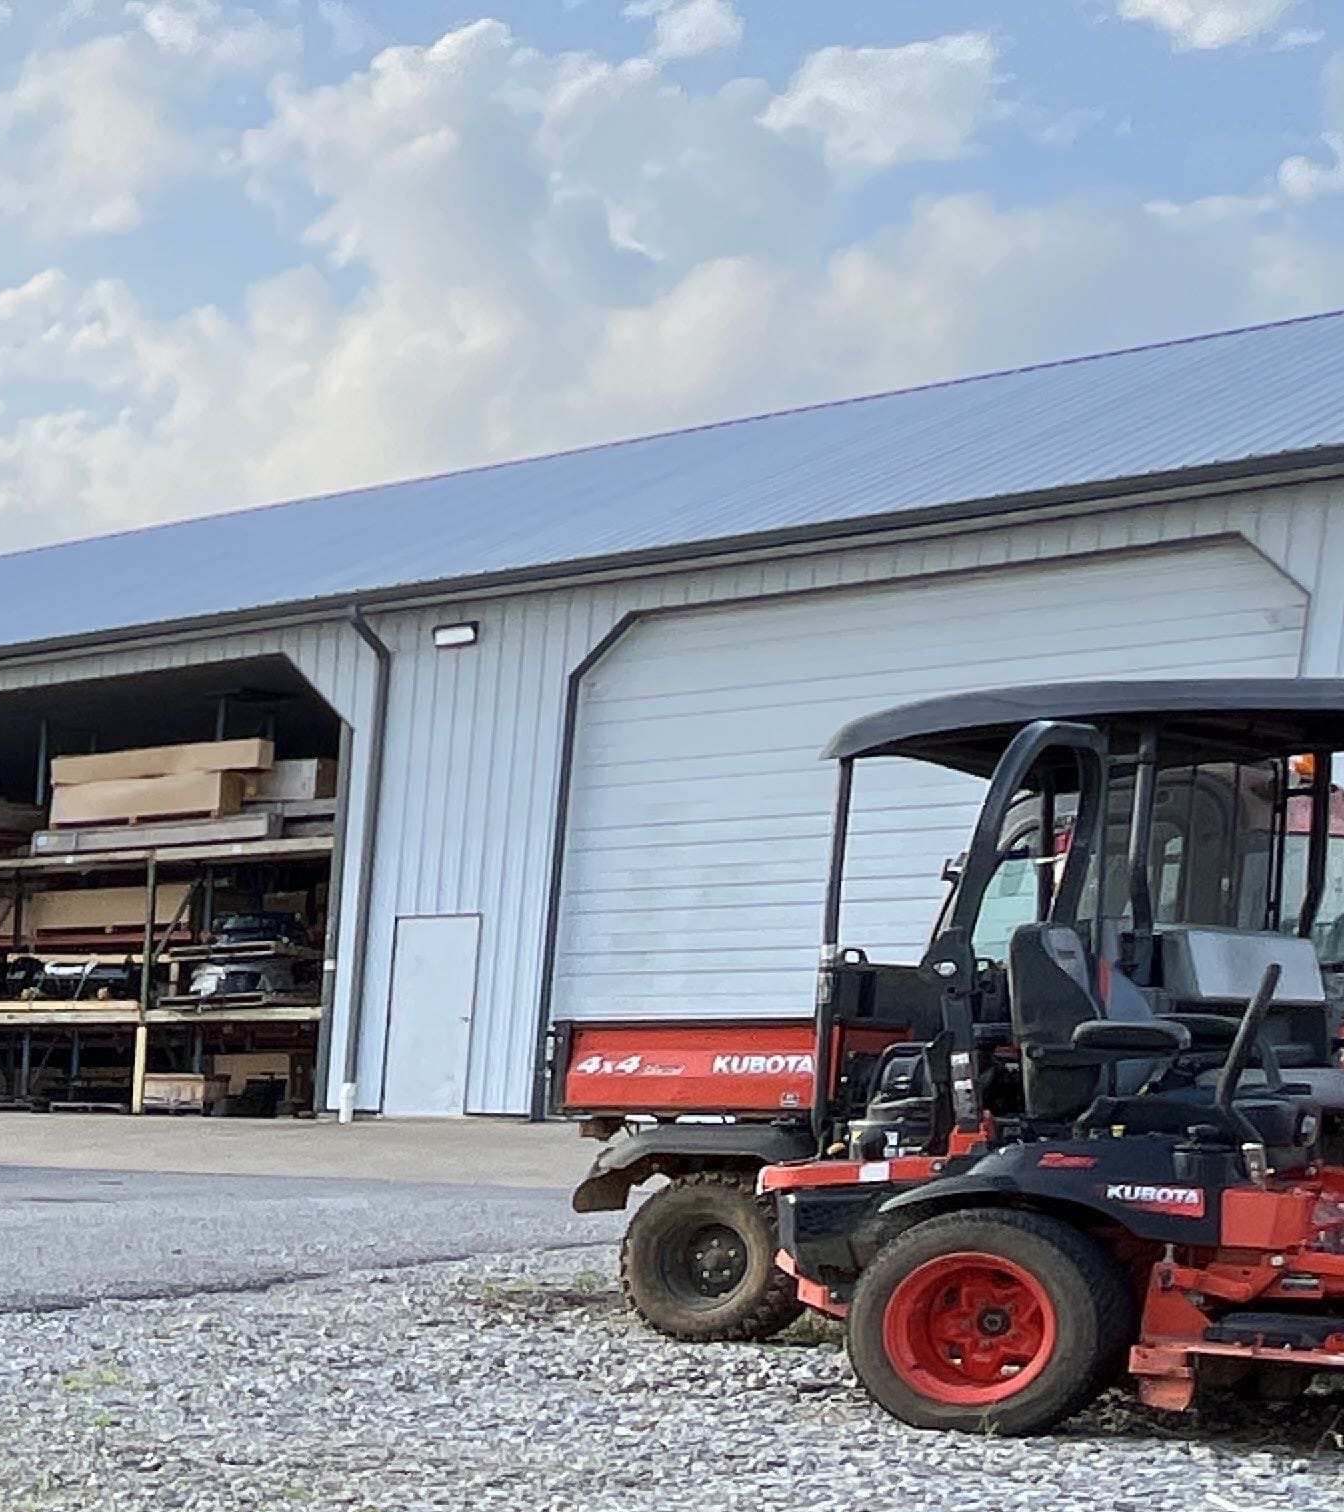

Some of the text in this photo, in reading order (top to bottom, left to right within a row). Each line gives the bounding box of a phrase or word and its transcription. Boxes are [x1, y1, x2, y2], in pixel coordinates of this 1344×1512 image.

[576, 1055, 642, 1075] 4x4
[712, 1055, 814, 1075] KUBOTA
[1106, 1184, 1200, 1204] KUBOTA
